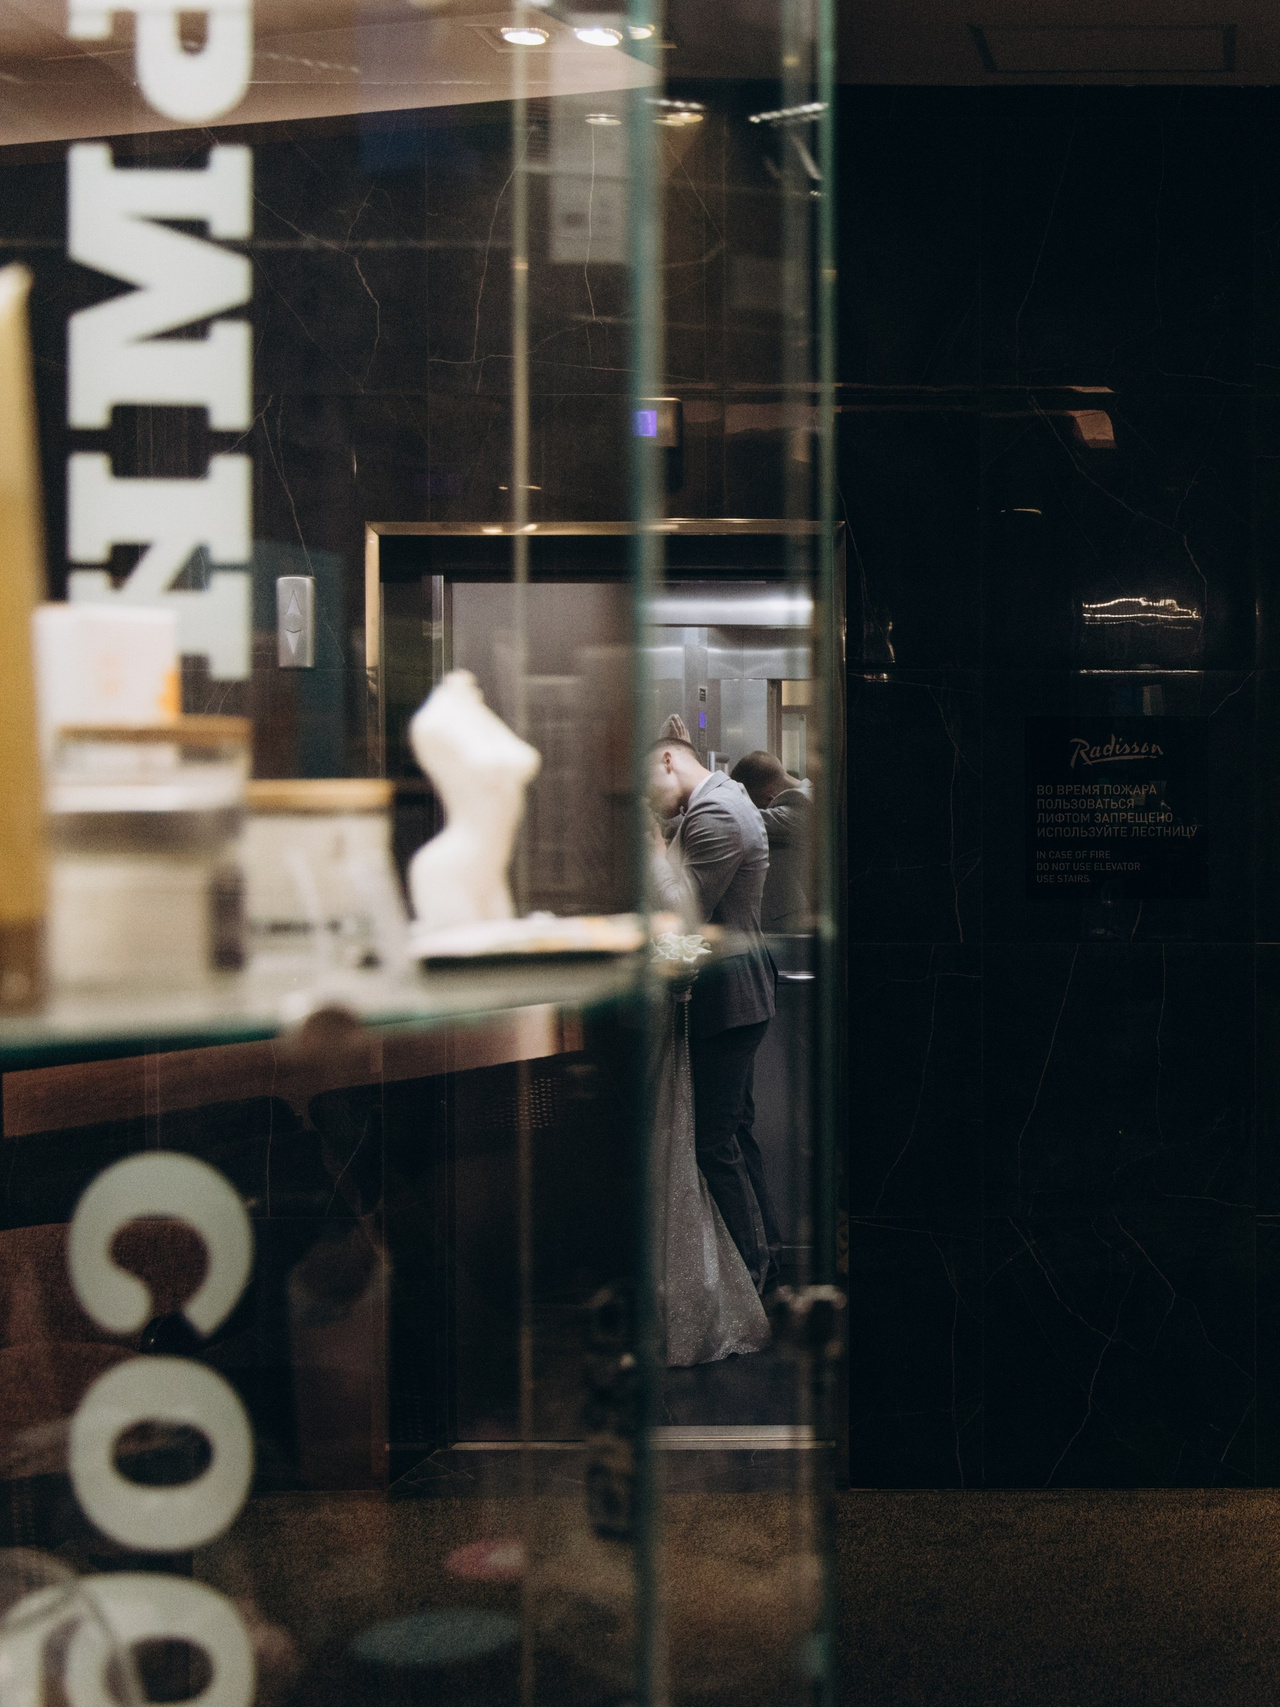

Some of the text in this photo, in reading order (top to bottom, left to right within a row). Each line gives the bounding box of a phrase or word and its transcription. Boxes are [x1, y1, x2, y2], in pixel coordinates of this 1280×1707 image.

[1069, 732, 1164, 769] Radisson
[1036, 784, 1158, 795] ВО ВРЕМЯ ПОЖАРА
[1036, 798, 1135, 809] ПОЛЬЗОВАТЬСЯ
[1036, 812, 1173, 824] ЛИФТОМ ЗАПРЕЩЕНО
[1036, 824, 1198, 839] ИСПОЛЬЗУЙТЕ ЛЕСТНИЦУ
[1036, 850, 1111, 859] IN CASE OF FIRE
[1036, 862, 1141, 871] DO NOT USE ELEVATOR
[1036, 874, 1090, 883] USE STAIRS
